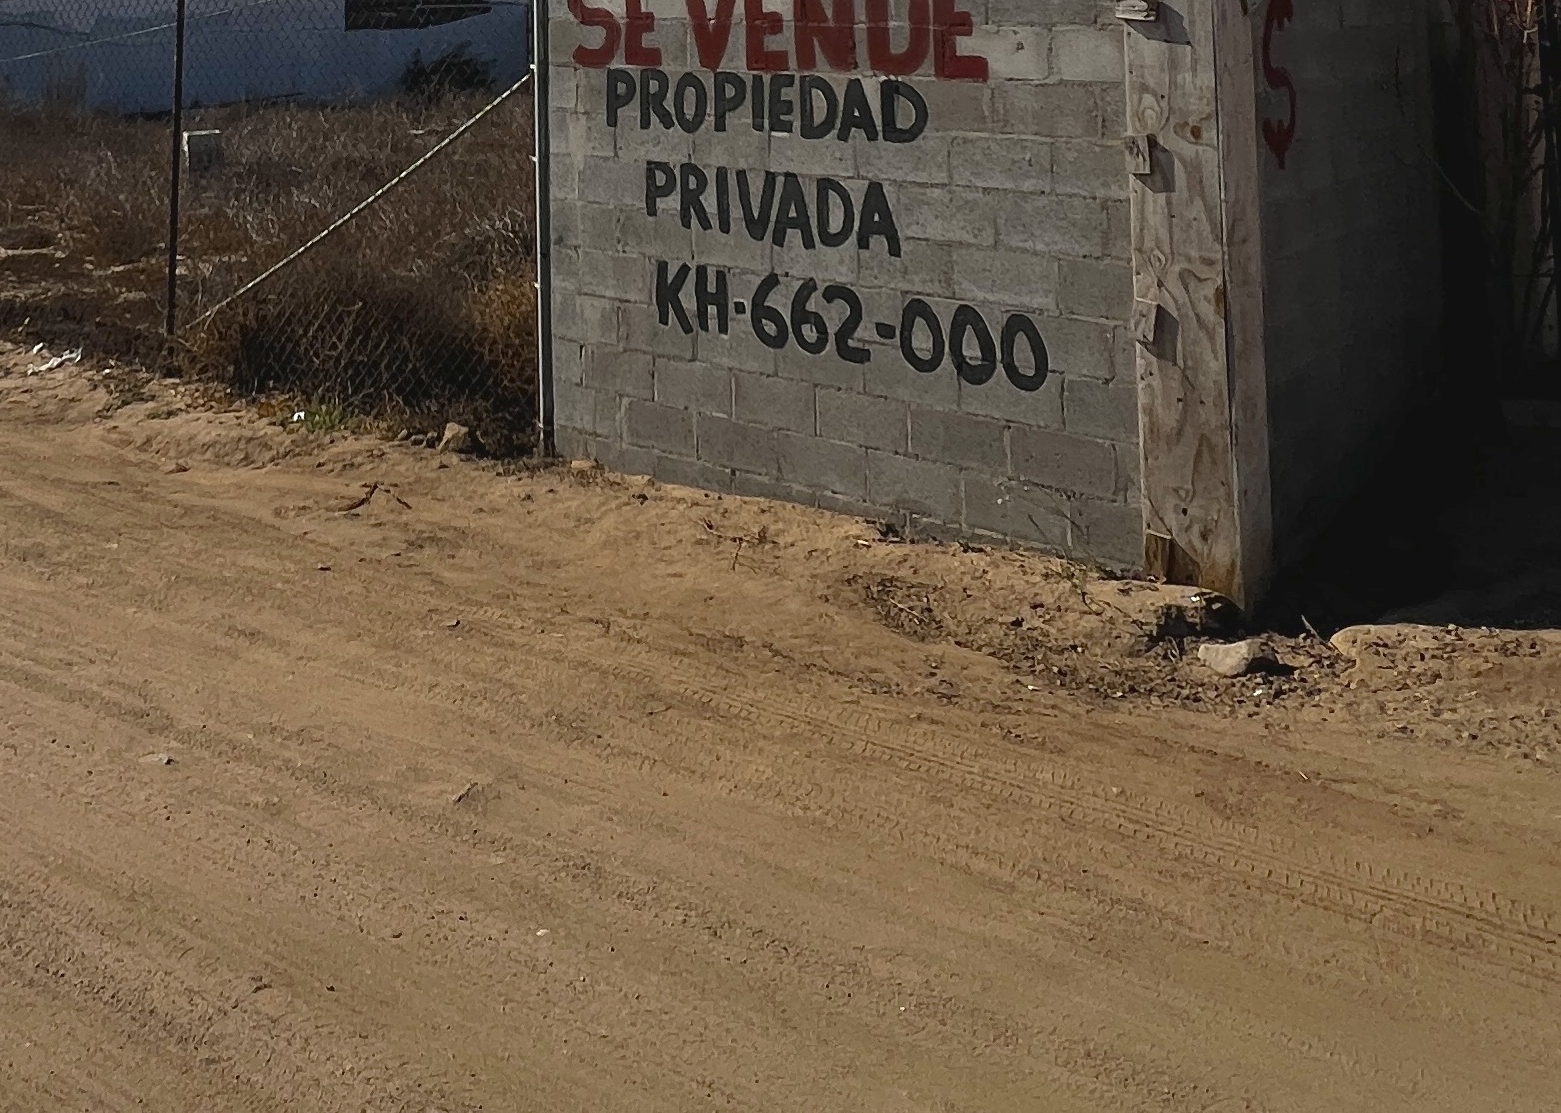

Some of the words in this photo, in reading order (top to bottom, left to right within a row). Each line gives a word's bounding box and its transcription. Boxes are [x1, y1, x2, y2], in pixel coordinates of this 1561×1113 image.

[606, 68, 929, 143] PROPIEDAD
[645, 160, 901, 258] PRIVADA
[655, 261, 1049, 392] KH-662-000
